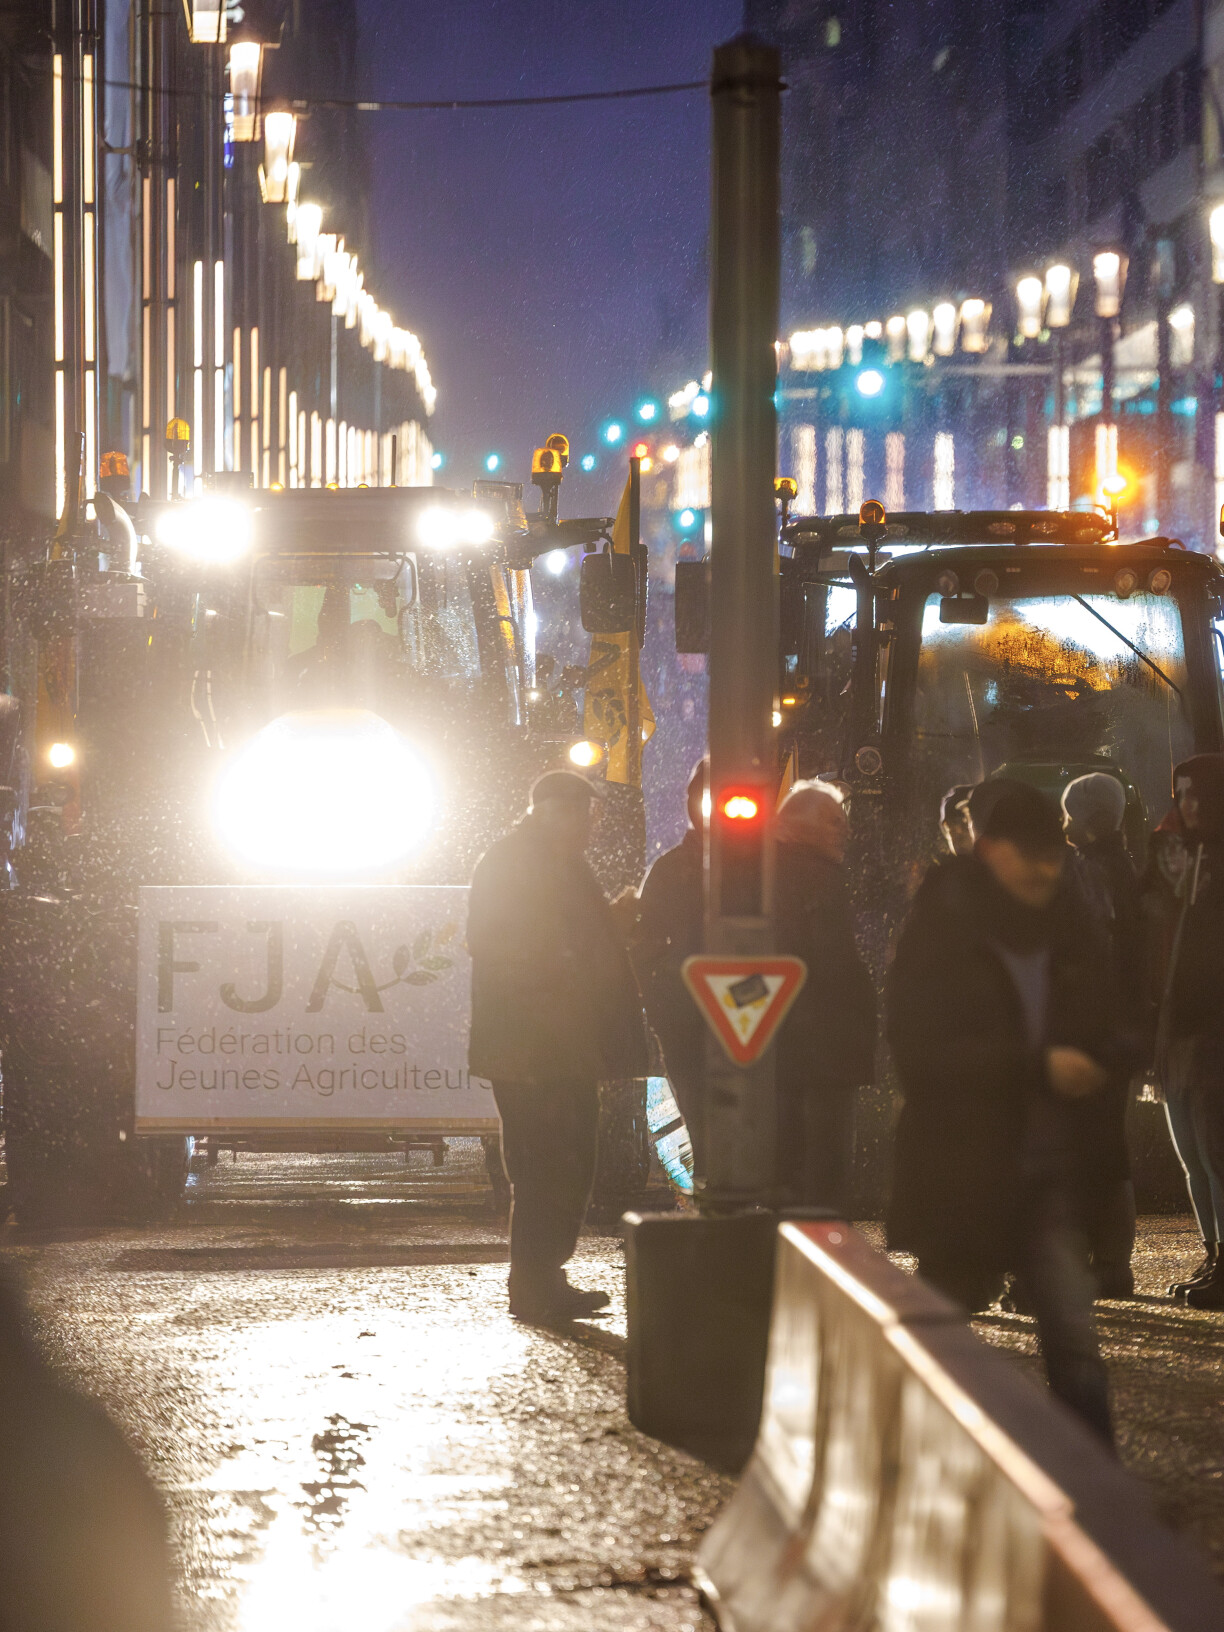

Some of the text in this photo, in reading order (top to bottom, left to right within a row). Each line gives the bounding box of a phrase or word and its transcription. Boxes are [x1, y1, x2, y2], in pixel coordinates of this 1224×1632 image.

[157, 920, 385, 1014] FJA
[157, 1026, 407, 1055] Fédération des
[156, 1060, 280, 1090] Jeunes
